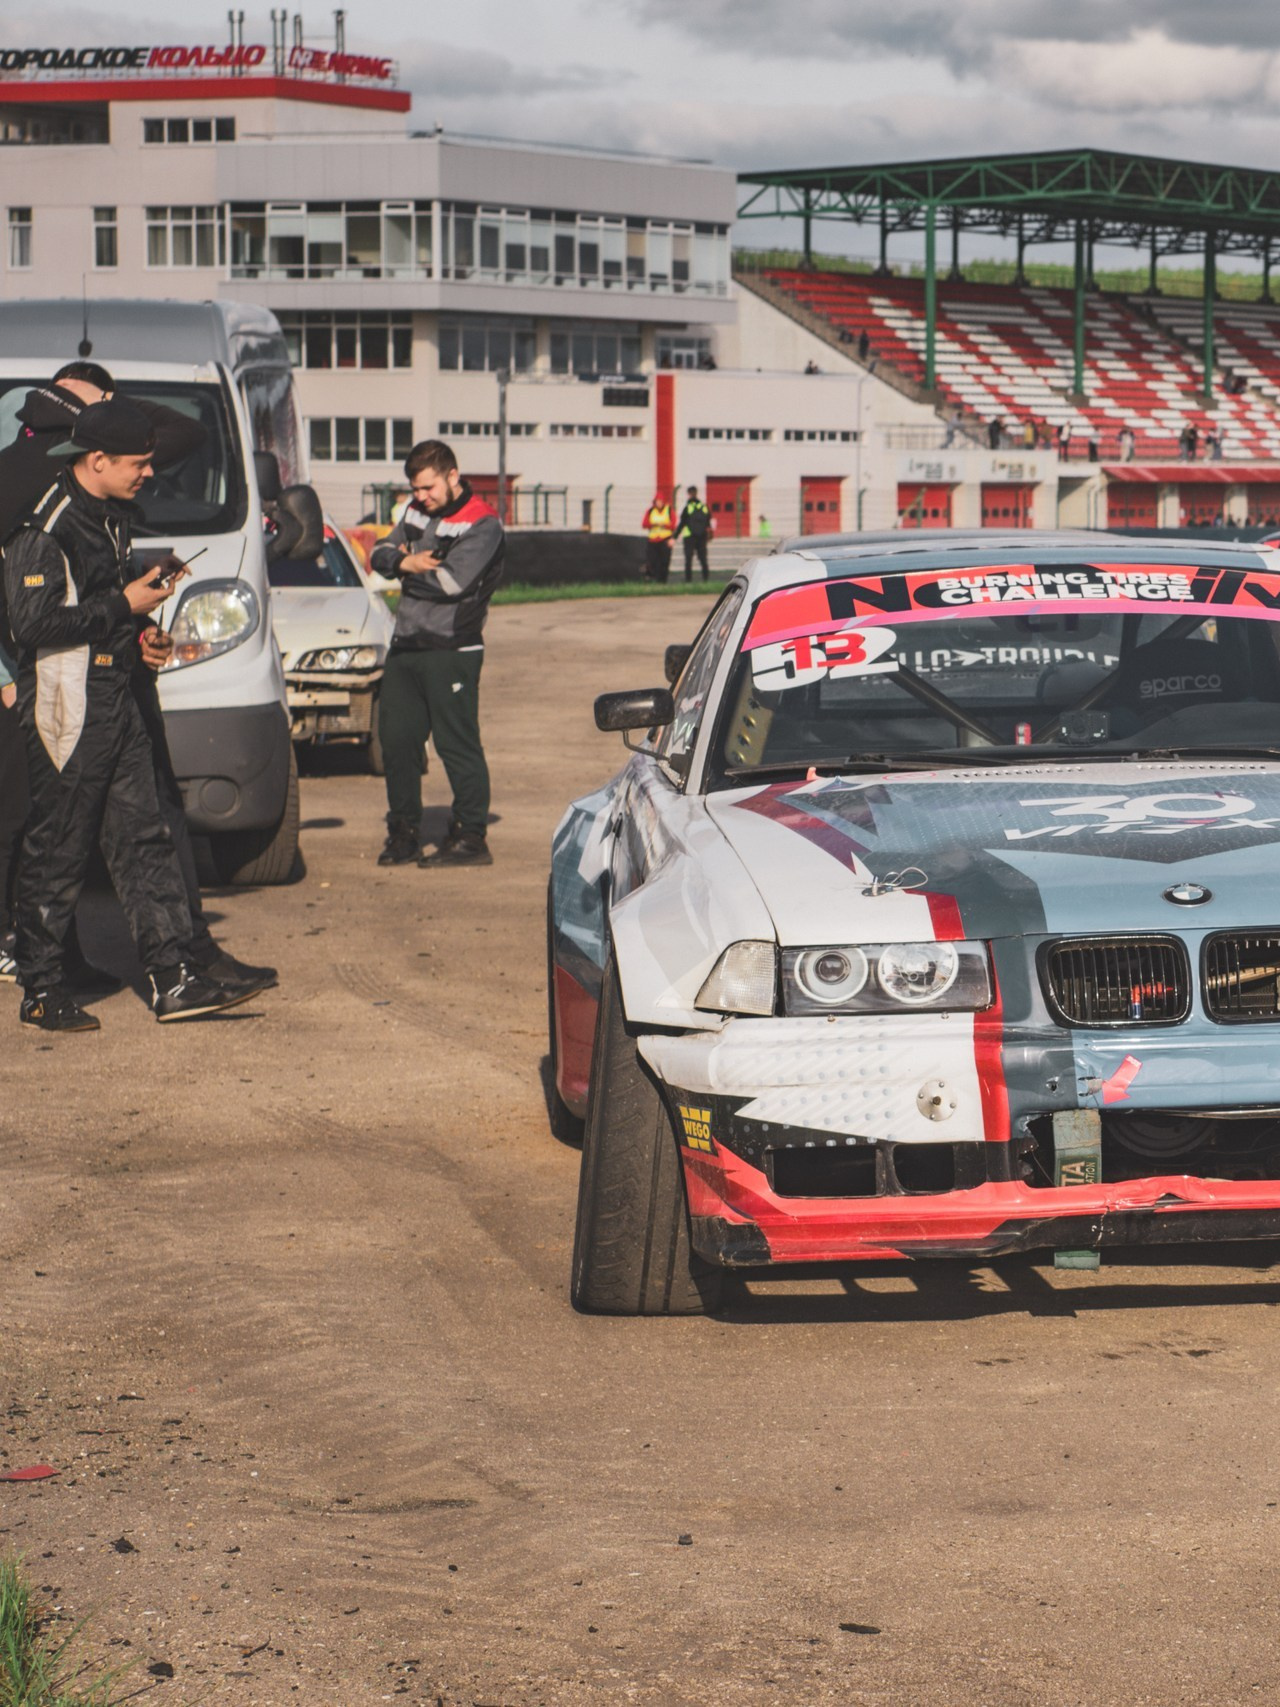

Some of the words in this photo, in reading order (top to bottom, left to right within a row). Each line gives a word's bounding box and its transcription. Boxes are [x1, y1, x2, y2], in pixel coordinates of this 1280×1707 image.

[0, 47, 149, 69] ОРОДСКОЕ
[147, 45, 266, 68] КОЛЬЦО
[937, 572, 1088, 590] BURNING
[1095, 572, 1190, 585] TIRES
[941, 584, 1194, 605] CHALLENGE
[781, 633, 866, 670] 13
[1140, 674, 1221, 699] sparco
[1020, 793, 1257, 822] 30
[683, 1119, 710, 1140] WEGO
